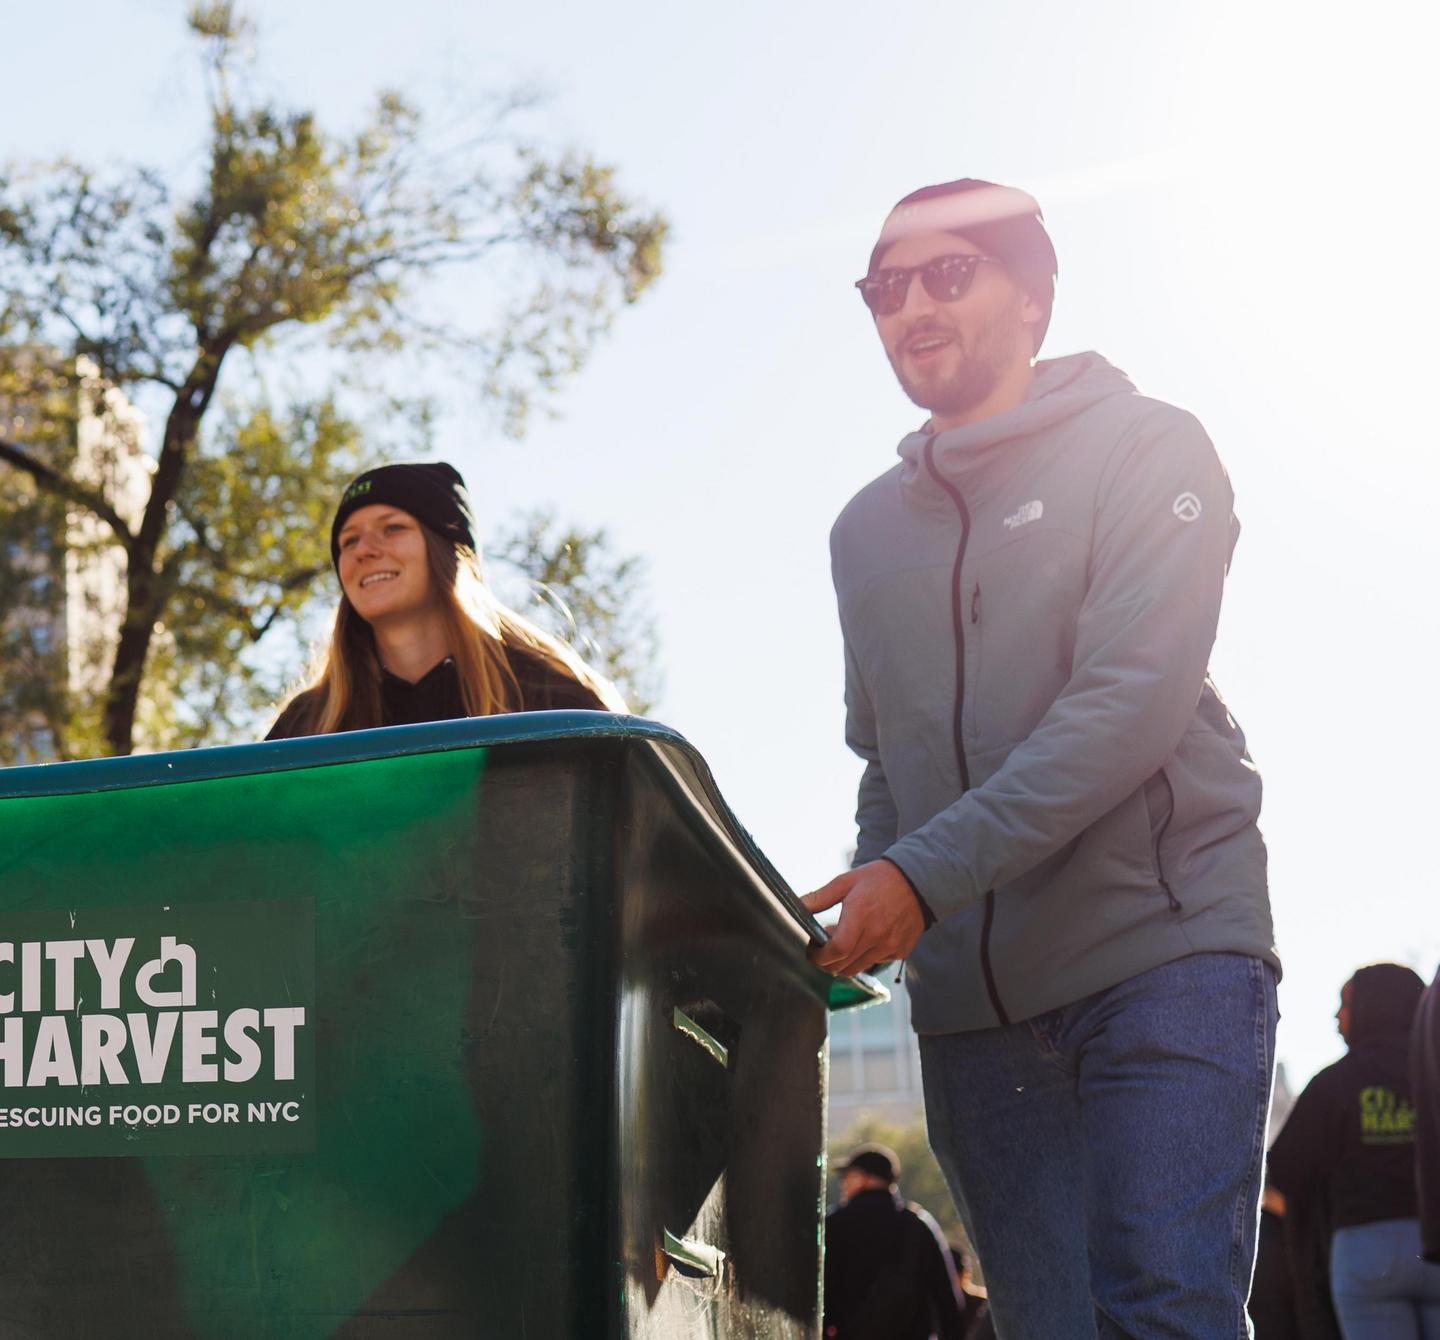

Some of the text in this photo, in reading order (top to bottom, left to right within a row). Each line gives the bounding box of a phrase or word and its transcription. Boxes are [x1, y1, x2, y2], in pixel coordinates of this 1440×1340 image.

[109, 1104, 181, 1126] FOOD
[188, 1103, 240, 1124] FOR
[247, 1101, 300, 1123] NYC
